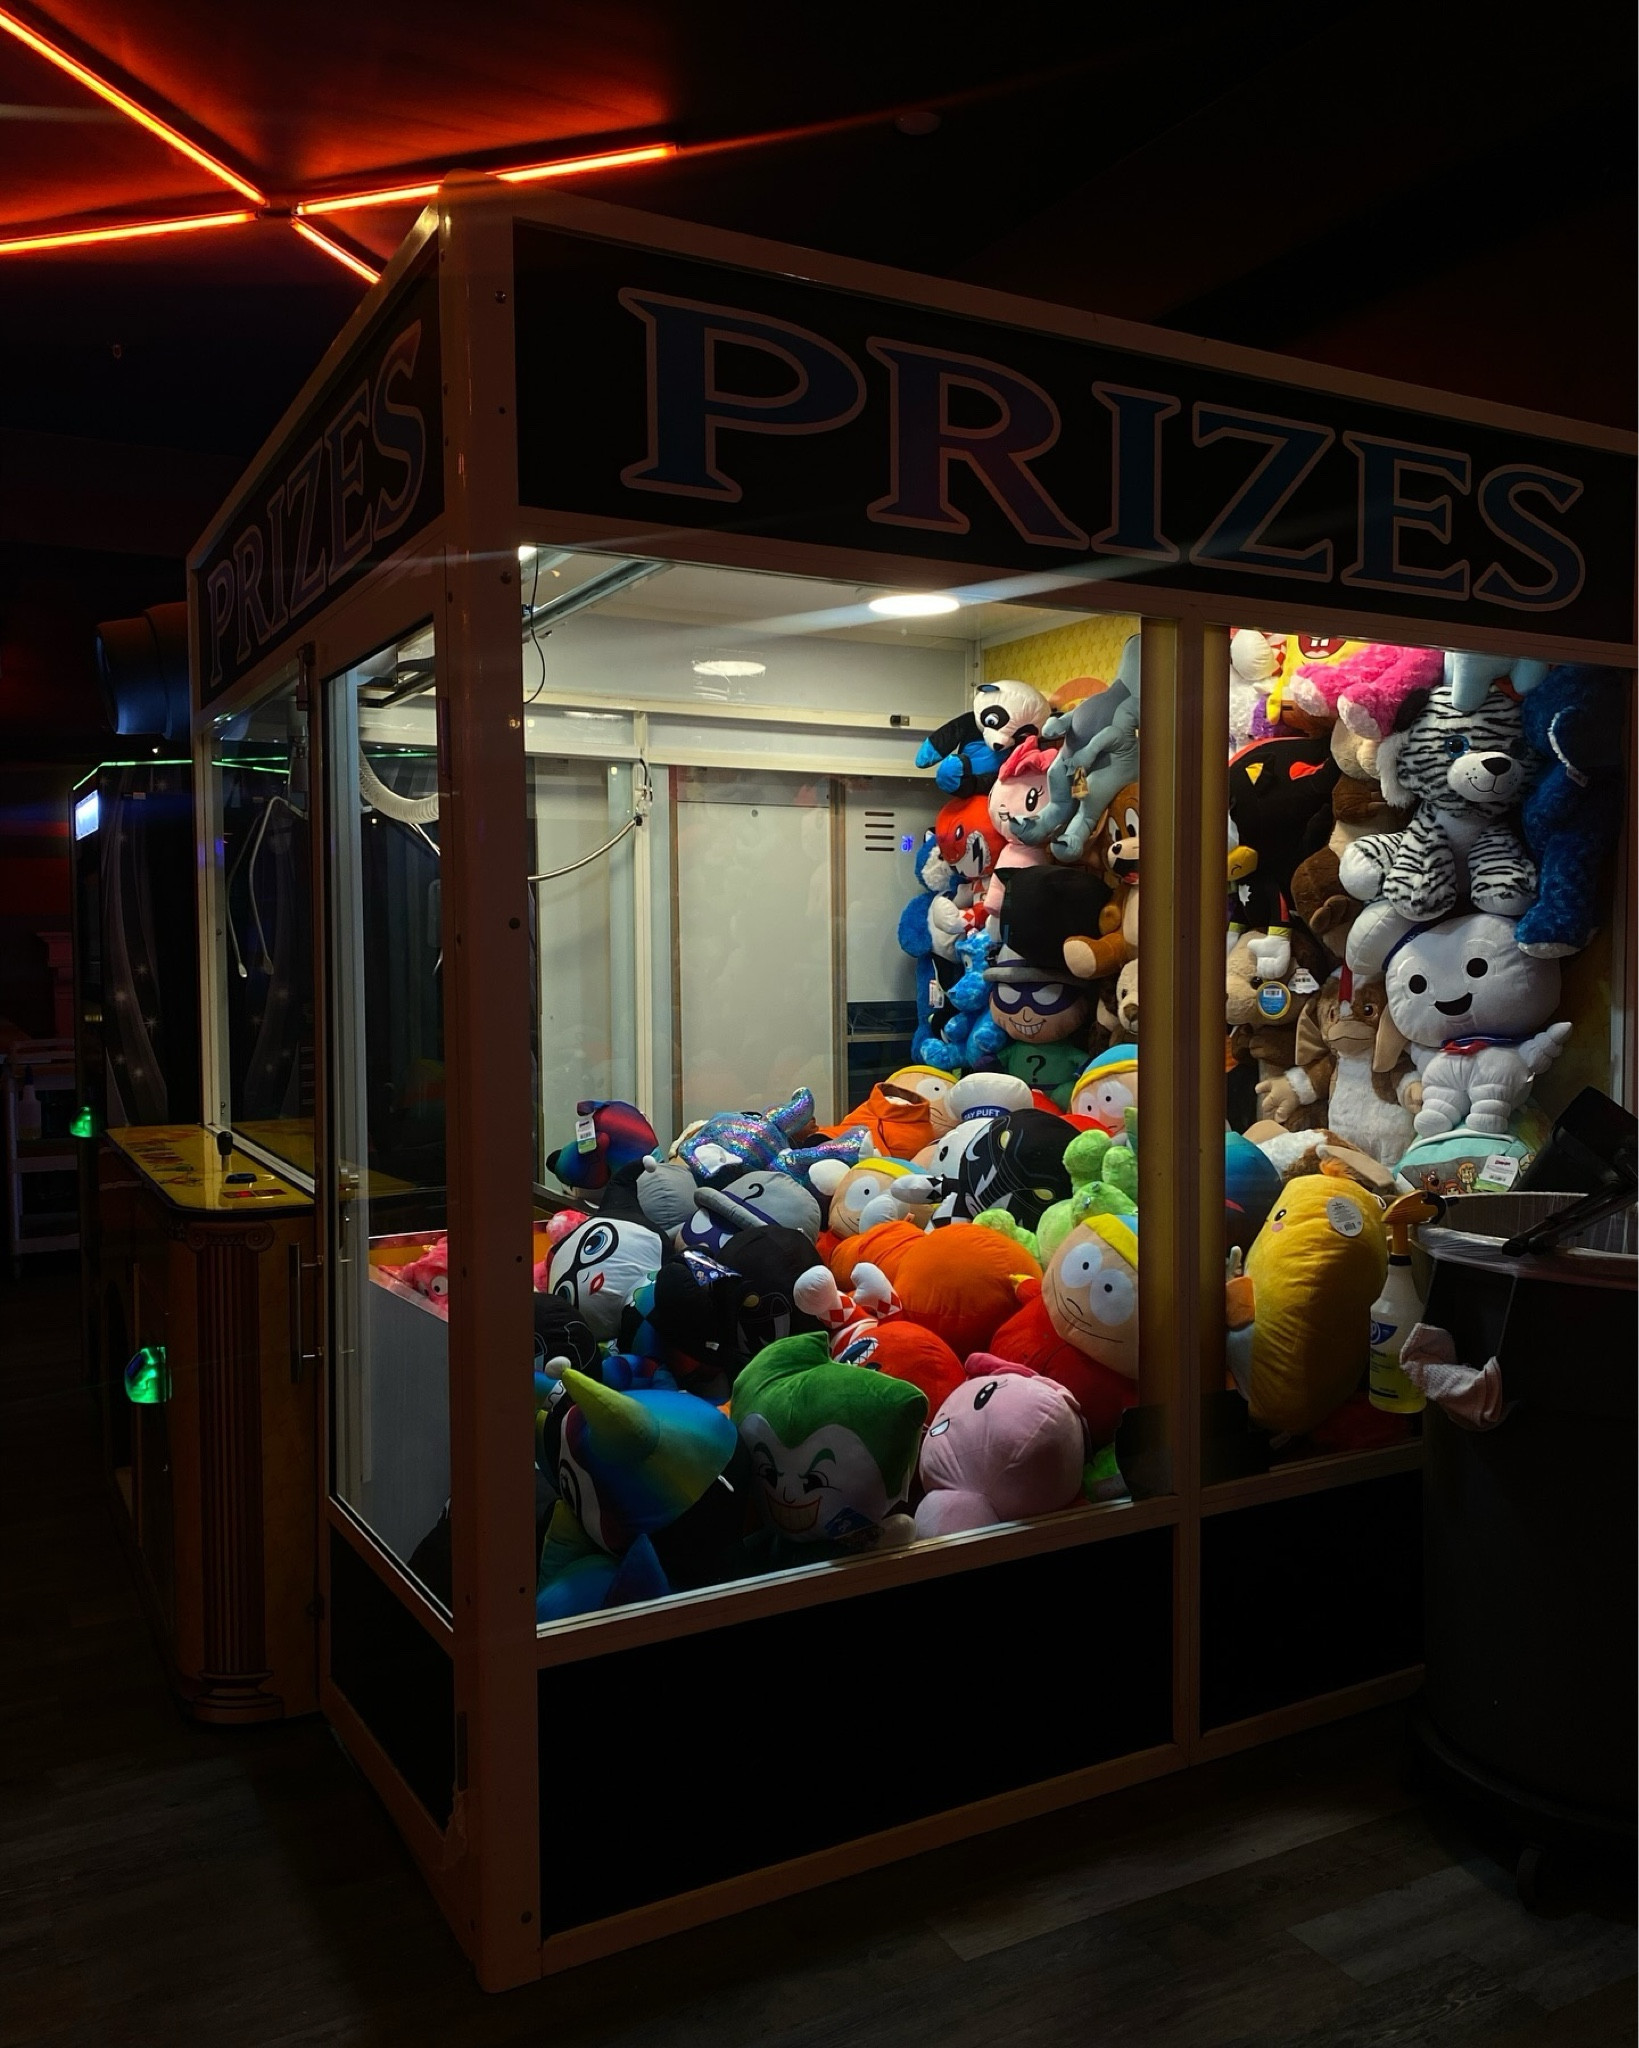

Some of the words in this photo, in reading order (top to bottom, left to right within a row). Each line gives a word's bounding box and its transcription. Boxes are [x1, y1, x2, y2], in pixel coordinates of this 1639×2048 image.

[206, 319, 425, 687] PRIZES
[618, 286, 1585, 612] PRIZES
[975, 1108, 1000, 1117] PUFT
